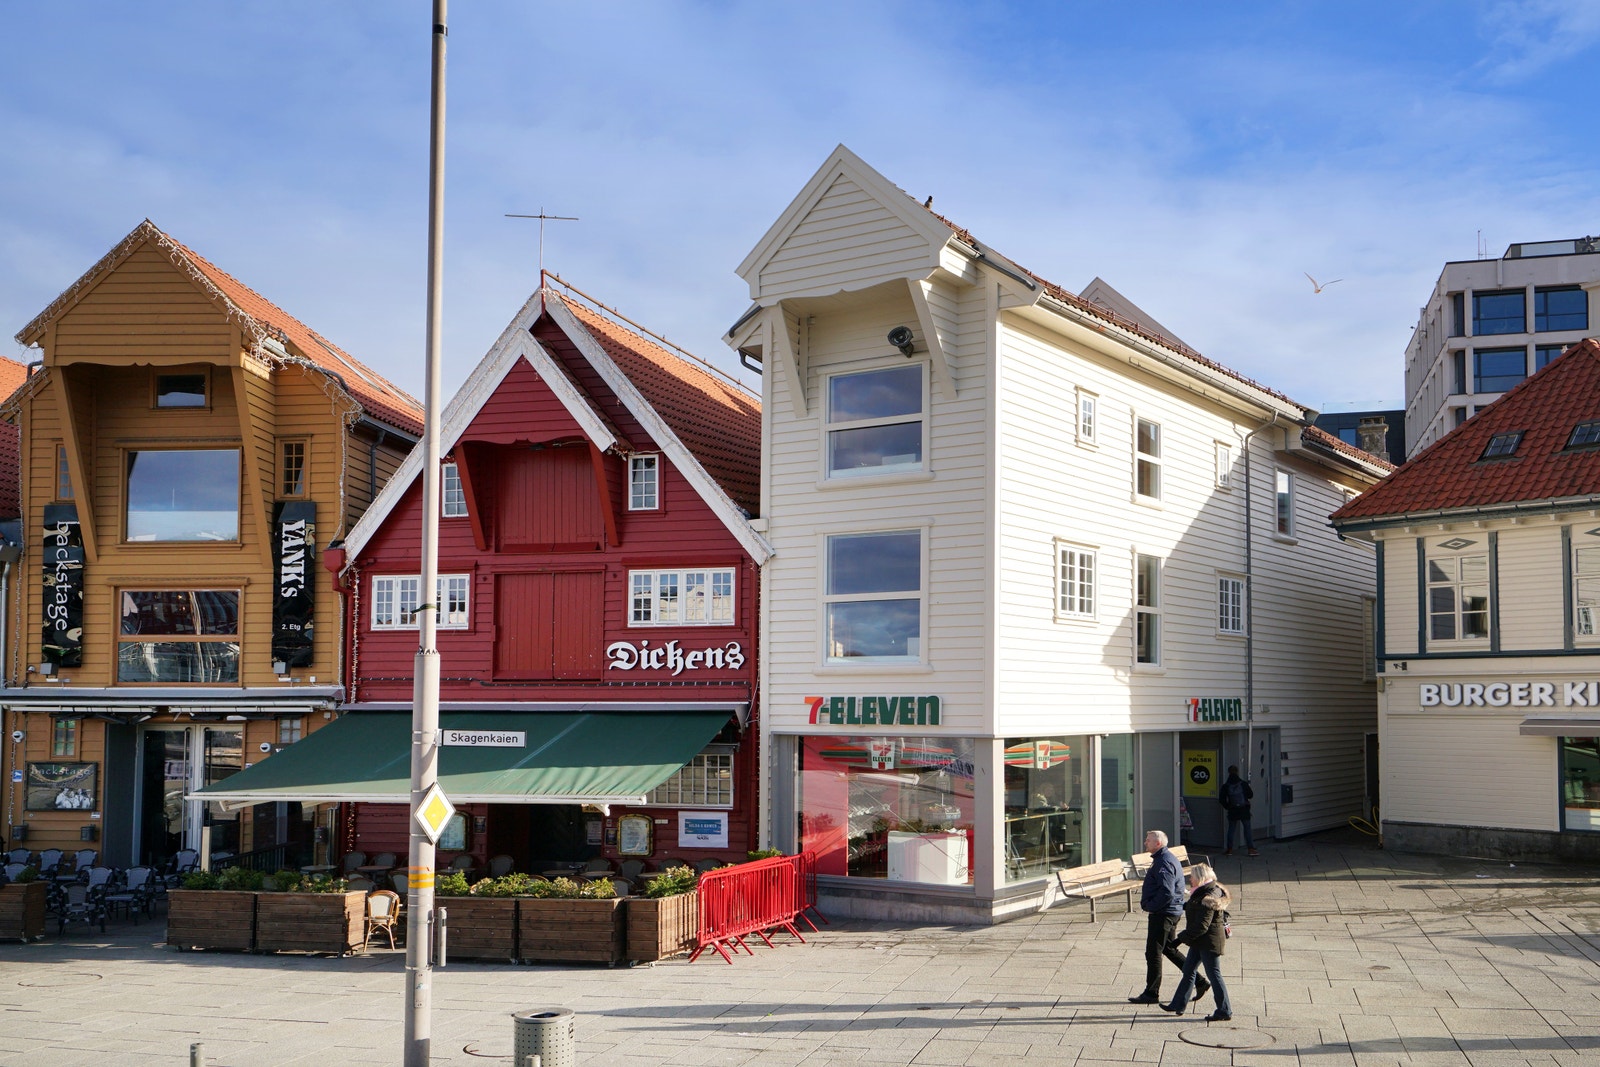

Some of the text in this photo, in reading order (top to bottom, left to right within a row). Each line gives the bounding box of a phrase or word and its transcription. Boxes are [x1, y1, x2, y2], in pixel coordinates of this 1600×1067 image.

[47, 521, 80, 631] backstage
[289, 623, 301, 631] Etg
[607, 639, 745, 676] Dickens
[1420, 682, 1555, 707] BURGER
[450, 732, 519, 744] Skagenkaien
